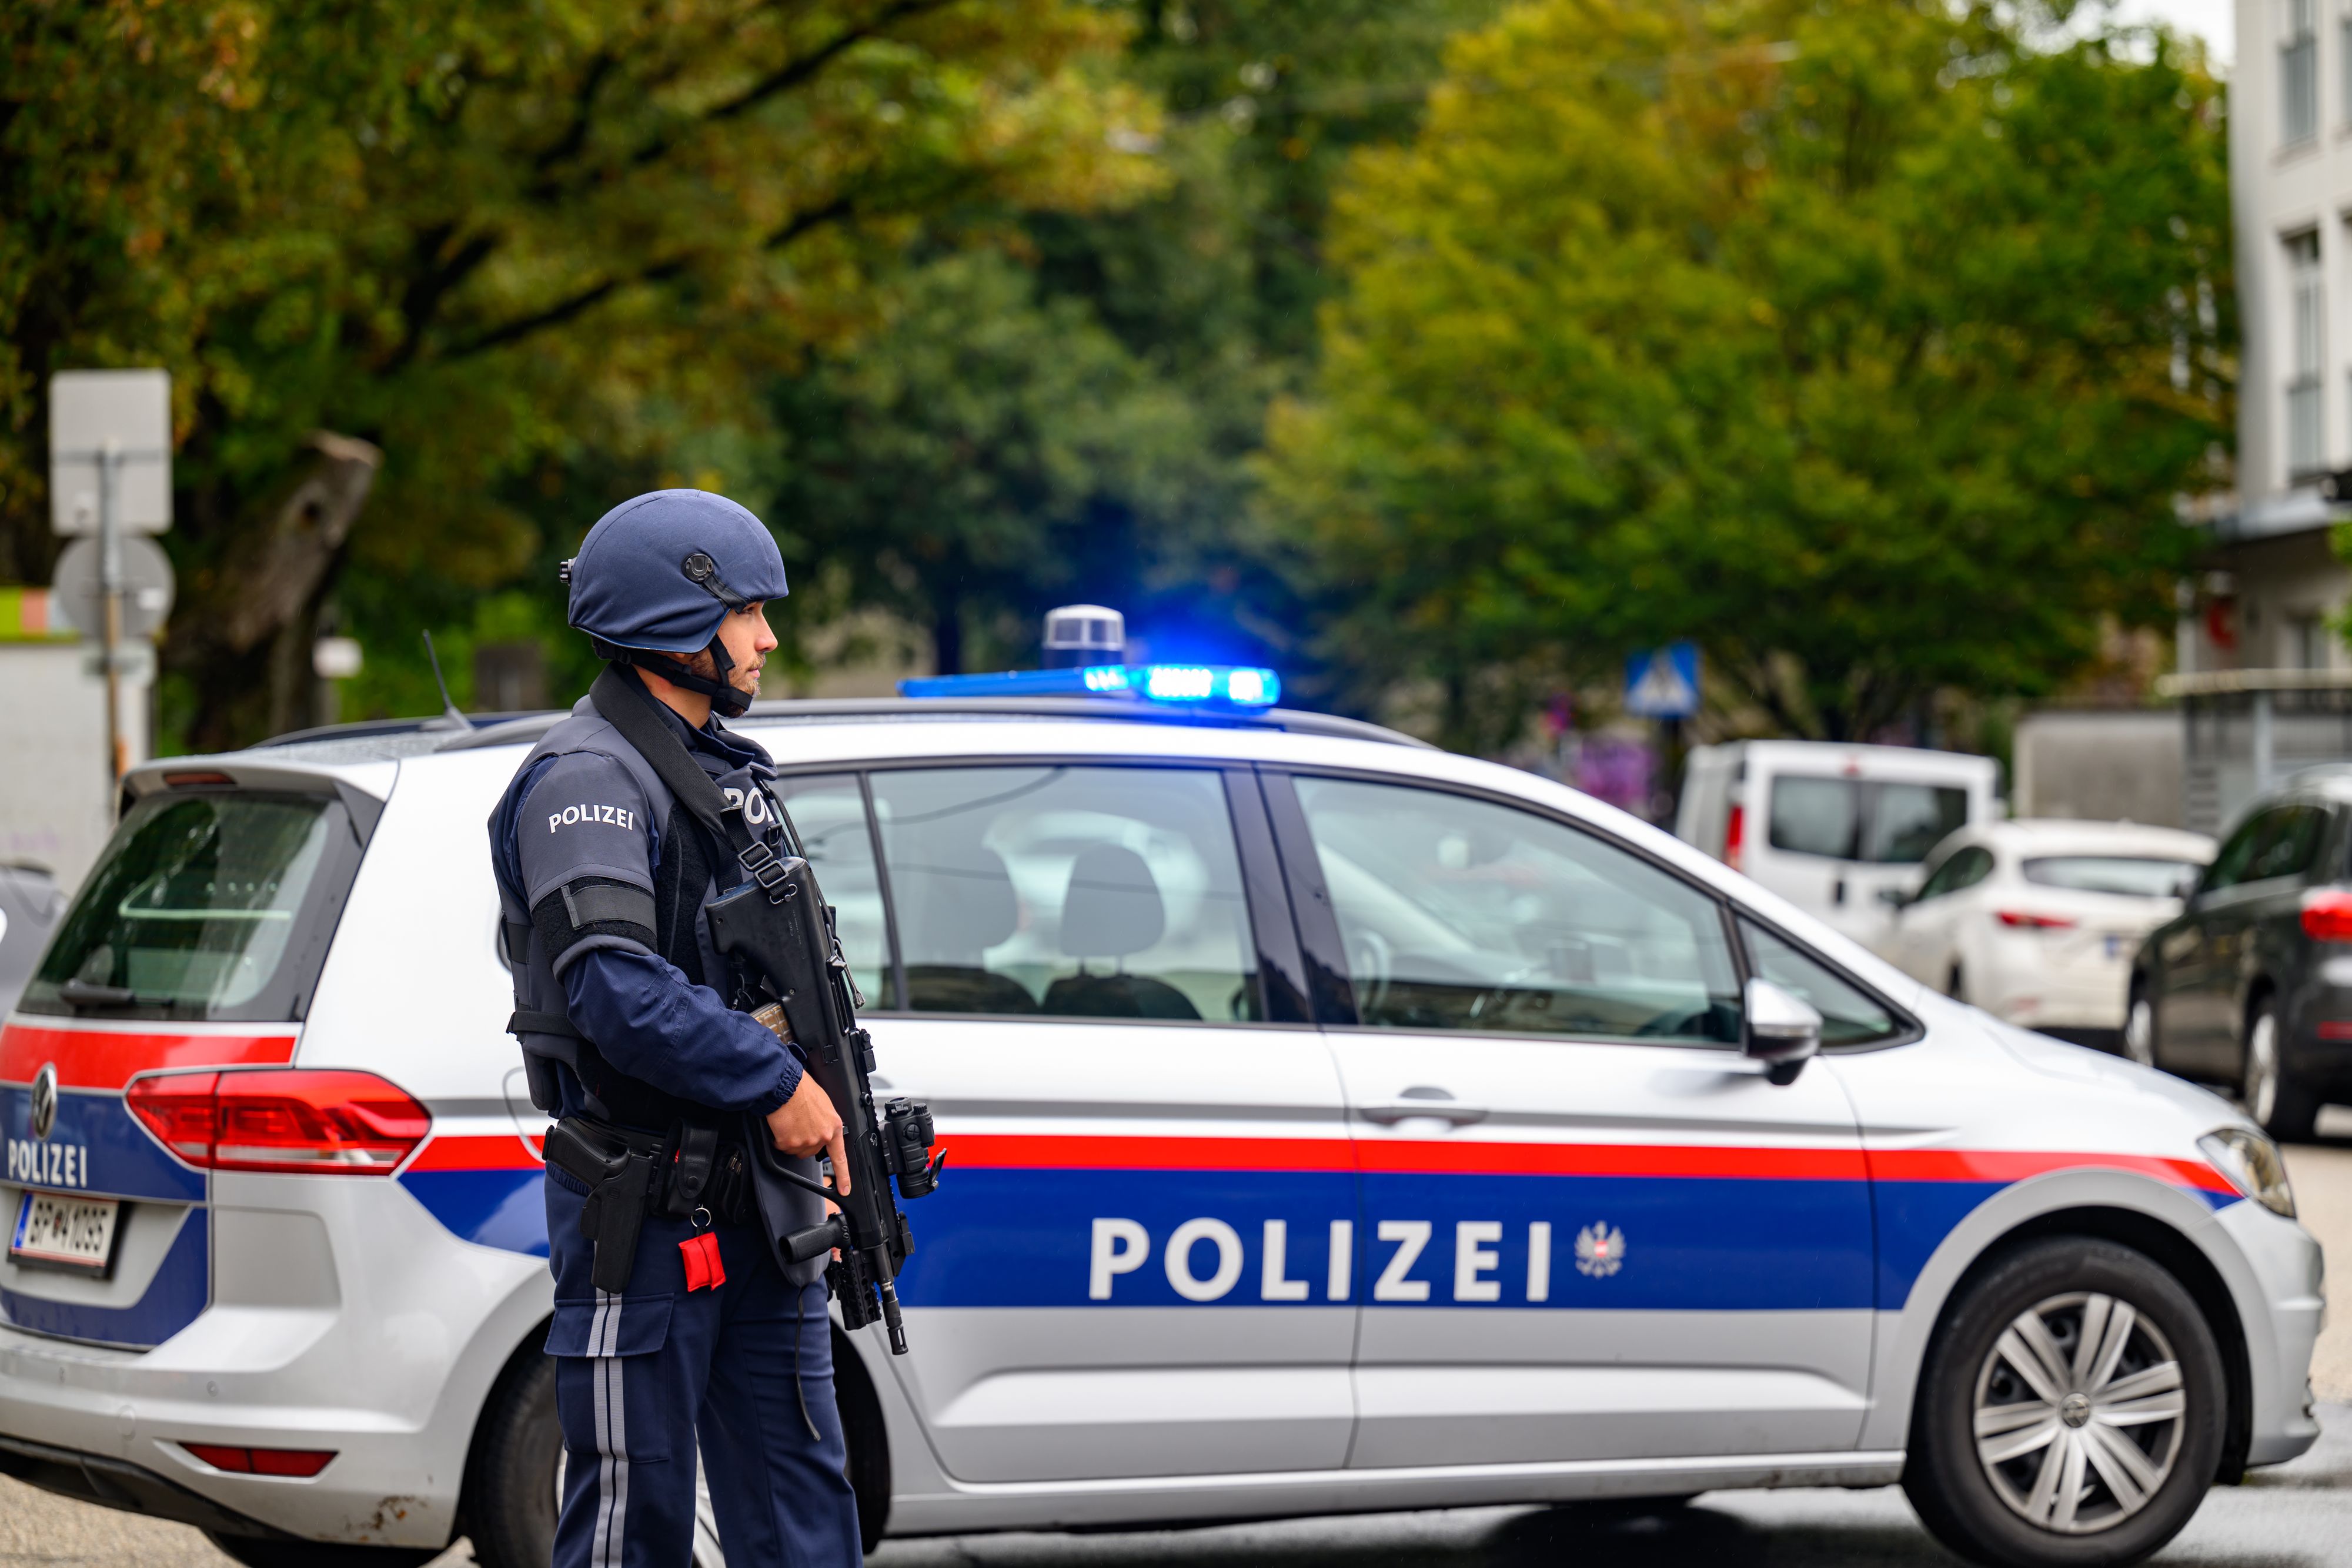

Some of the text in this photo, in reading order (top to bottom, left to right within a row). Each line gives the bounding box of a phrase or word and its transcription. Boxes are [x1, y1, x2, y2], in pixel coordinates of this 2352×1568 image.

[549, 804, 634, 834] POLIZEI
[8, 1139, 87, 1188] POLIZEI
[1088, 1217, 1552, 1302] POLIZEI
